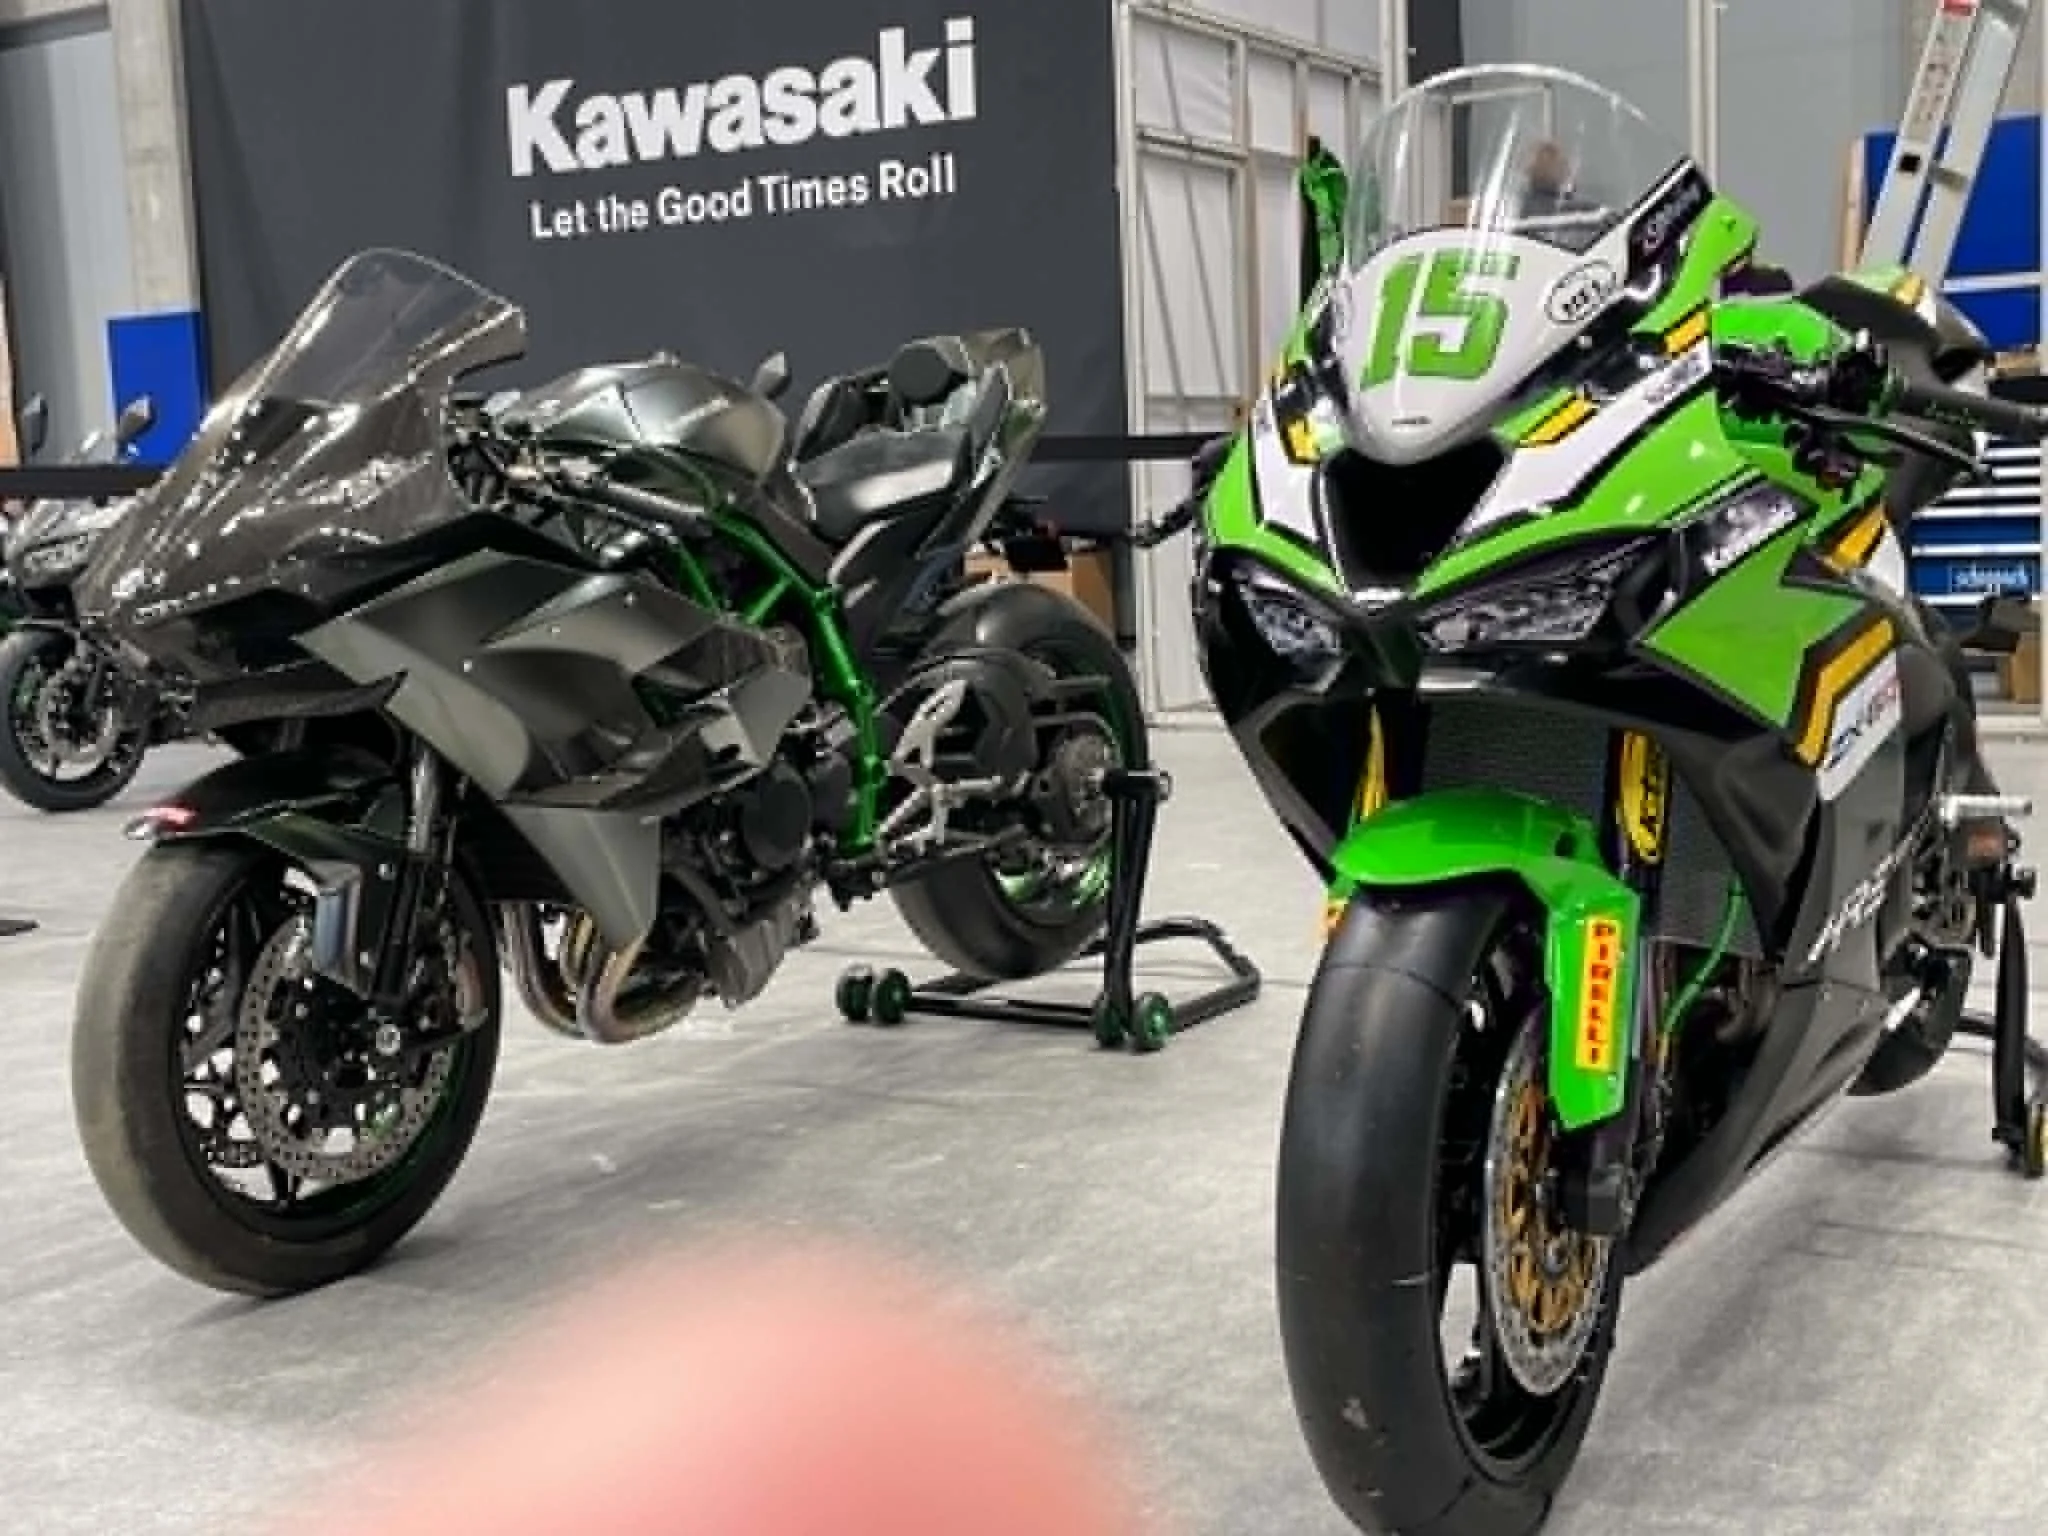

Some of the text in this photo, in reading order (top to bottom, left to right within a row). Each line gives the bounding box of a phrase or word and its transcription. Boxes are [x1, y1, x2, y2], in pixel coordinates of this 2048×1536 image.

[507, 16, 976, 177] Kawasaki
[530, 152, 957, 239] Let the Good Times Roll
[1360, 247, 1520, 391] 15
